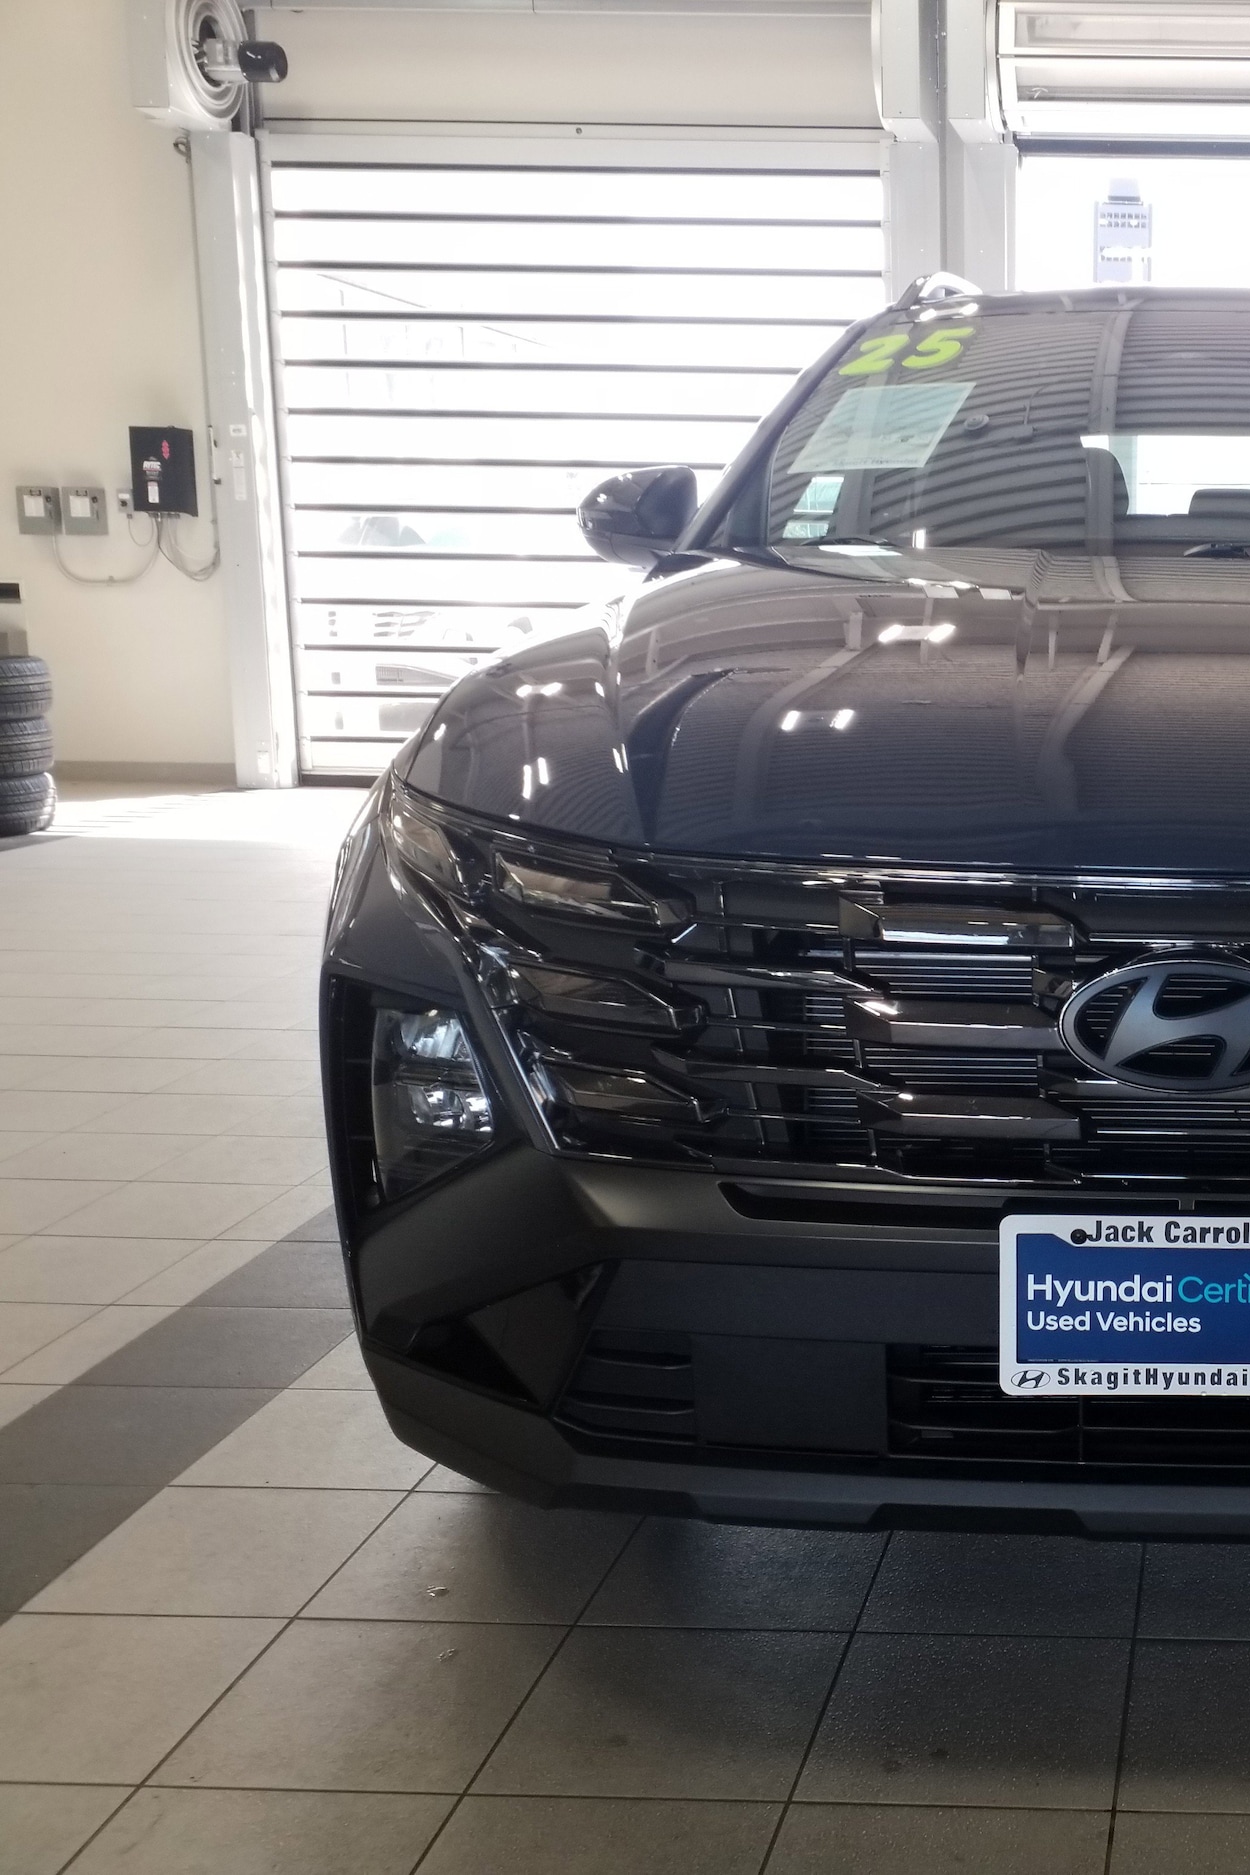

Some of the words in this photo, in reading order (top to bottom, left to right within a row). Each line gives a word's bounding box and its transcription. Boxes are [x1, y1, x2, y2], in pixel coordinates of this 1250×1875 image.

[838, 327, 976, 376] 25
[1087, 1220, 1154, 1243] Jack
[1027, 1274, 1173, 1307] Hyundai
[1027, 1311, 1090, 1331] Used
[1097, 1312, 1201, 1333] Vehicles
